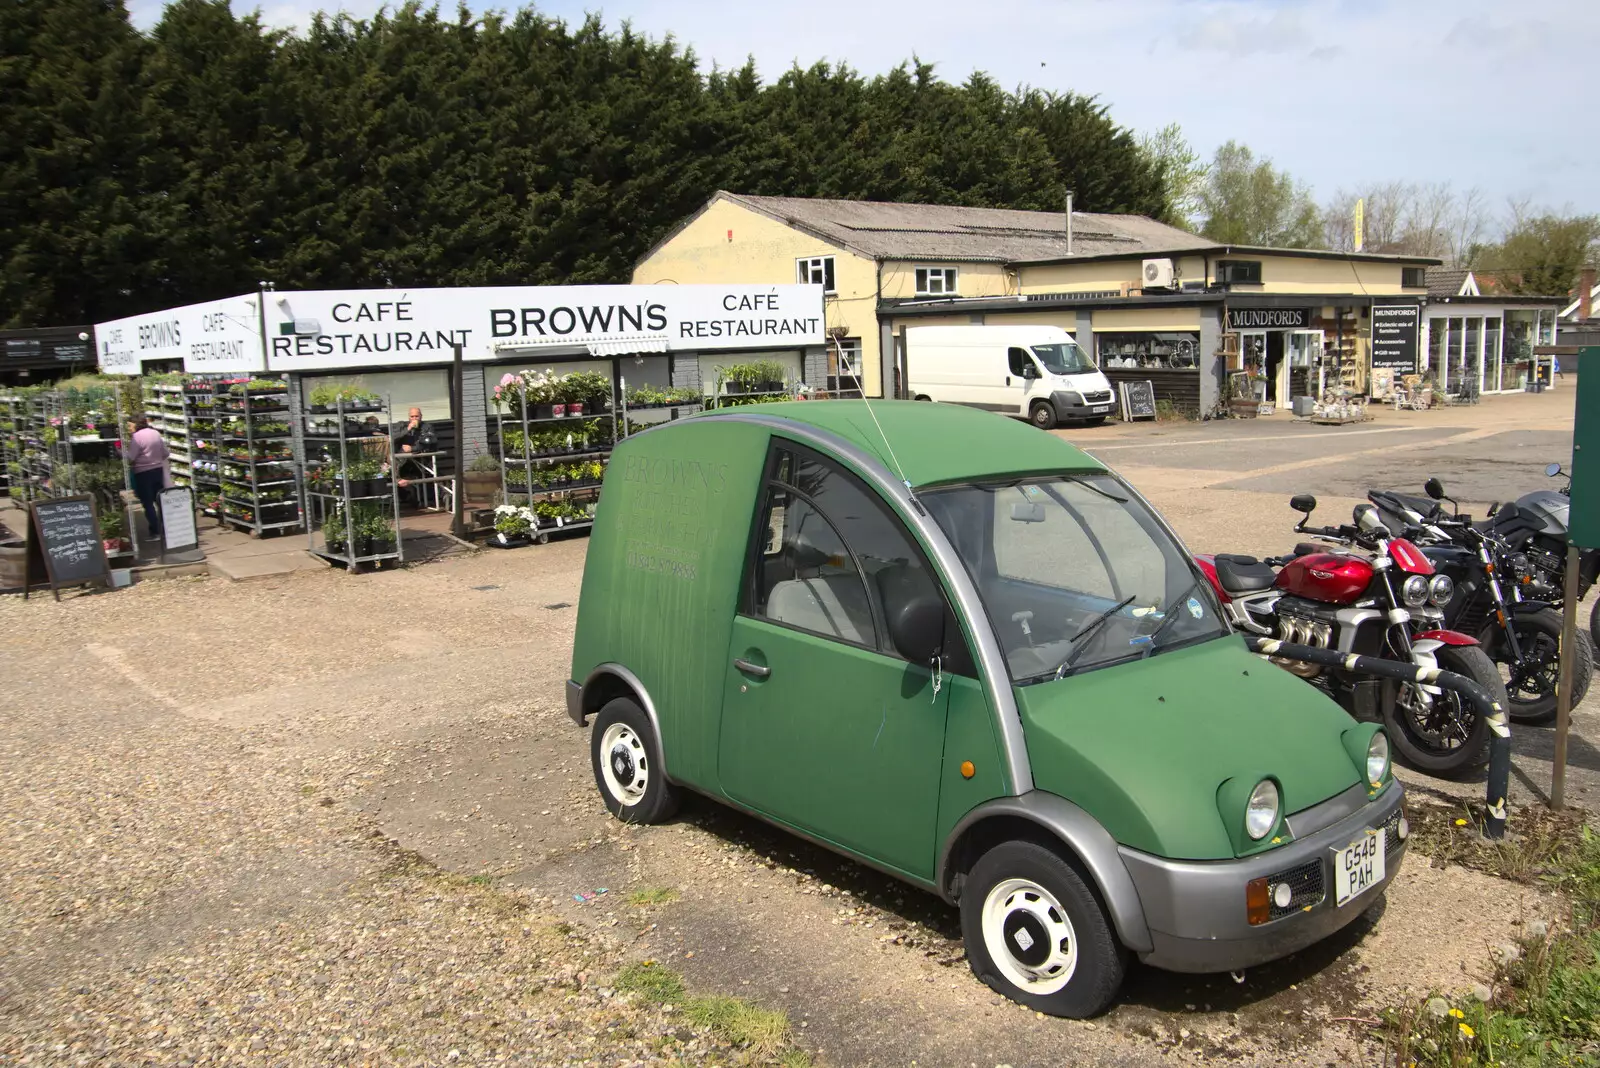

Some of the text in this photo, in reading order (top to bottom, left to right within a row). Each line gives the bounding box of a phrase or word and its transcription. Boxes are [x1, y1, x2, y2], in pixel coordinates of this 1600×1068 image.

[332, 293, 413, 323] CAFÉ
[722, 287, 779, 311] CAFÉ
[490, 300, 667, 338] BROWN'S
[680, 317, 819, 338] RESTAURANT
[1233, 310, 1302, 326] MUNDFORDS
[191, 340, 243, 360] RESTAURANT
[272, 329, 473, 357] RESTAURANT
[624, 455, 728, 494] BROWN'S
[1345, 835, 1377, 872] G548
[1349, 860, 1373, 894] PAH
